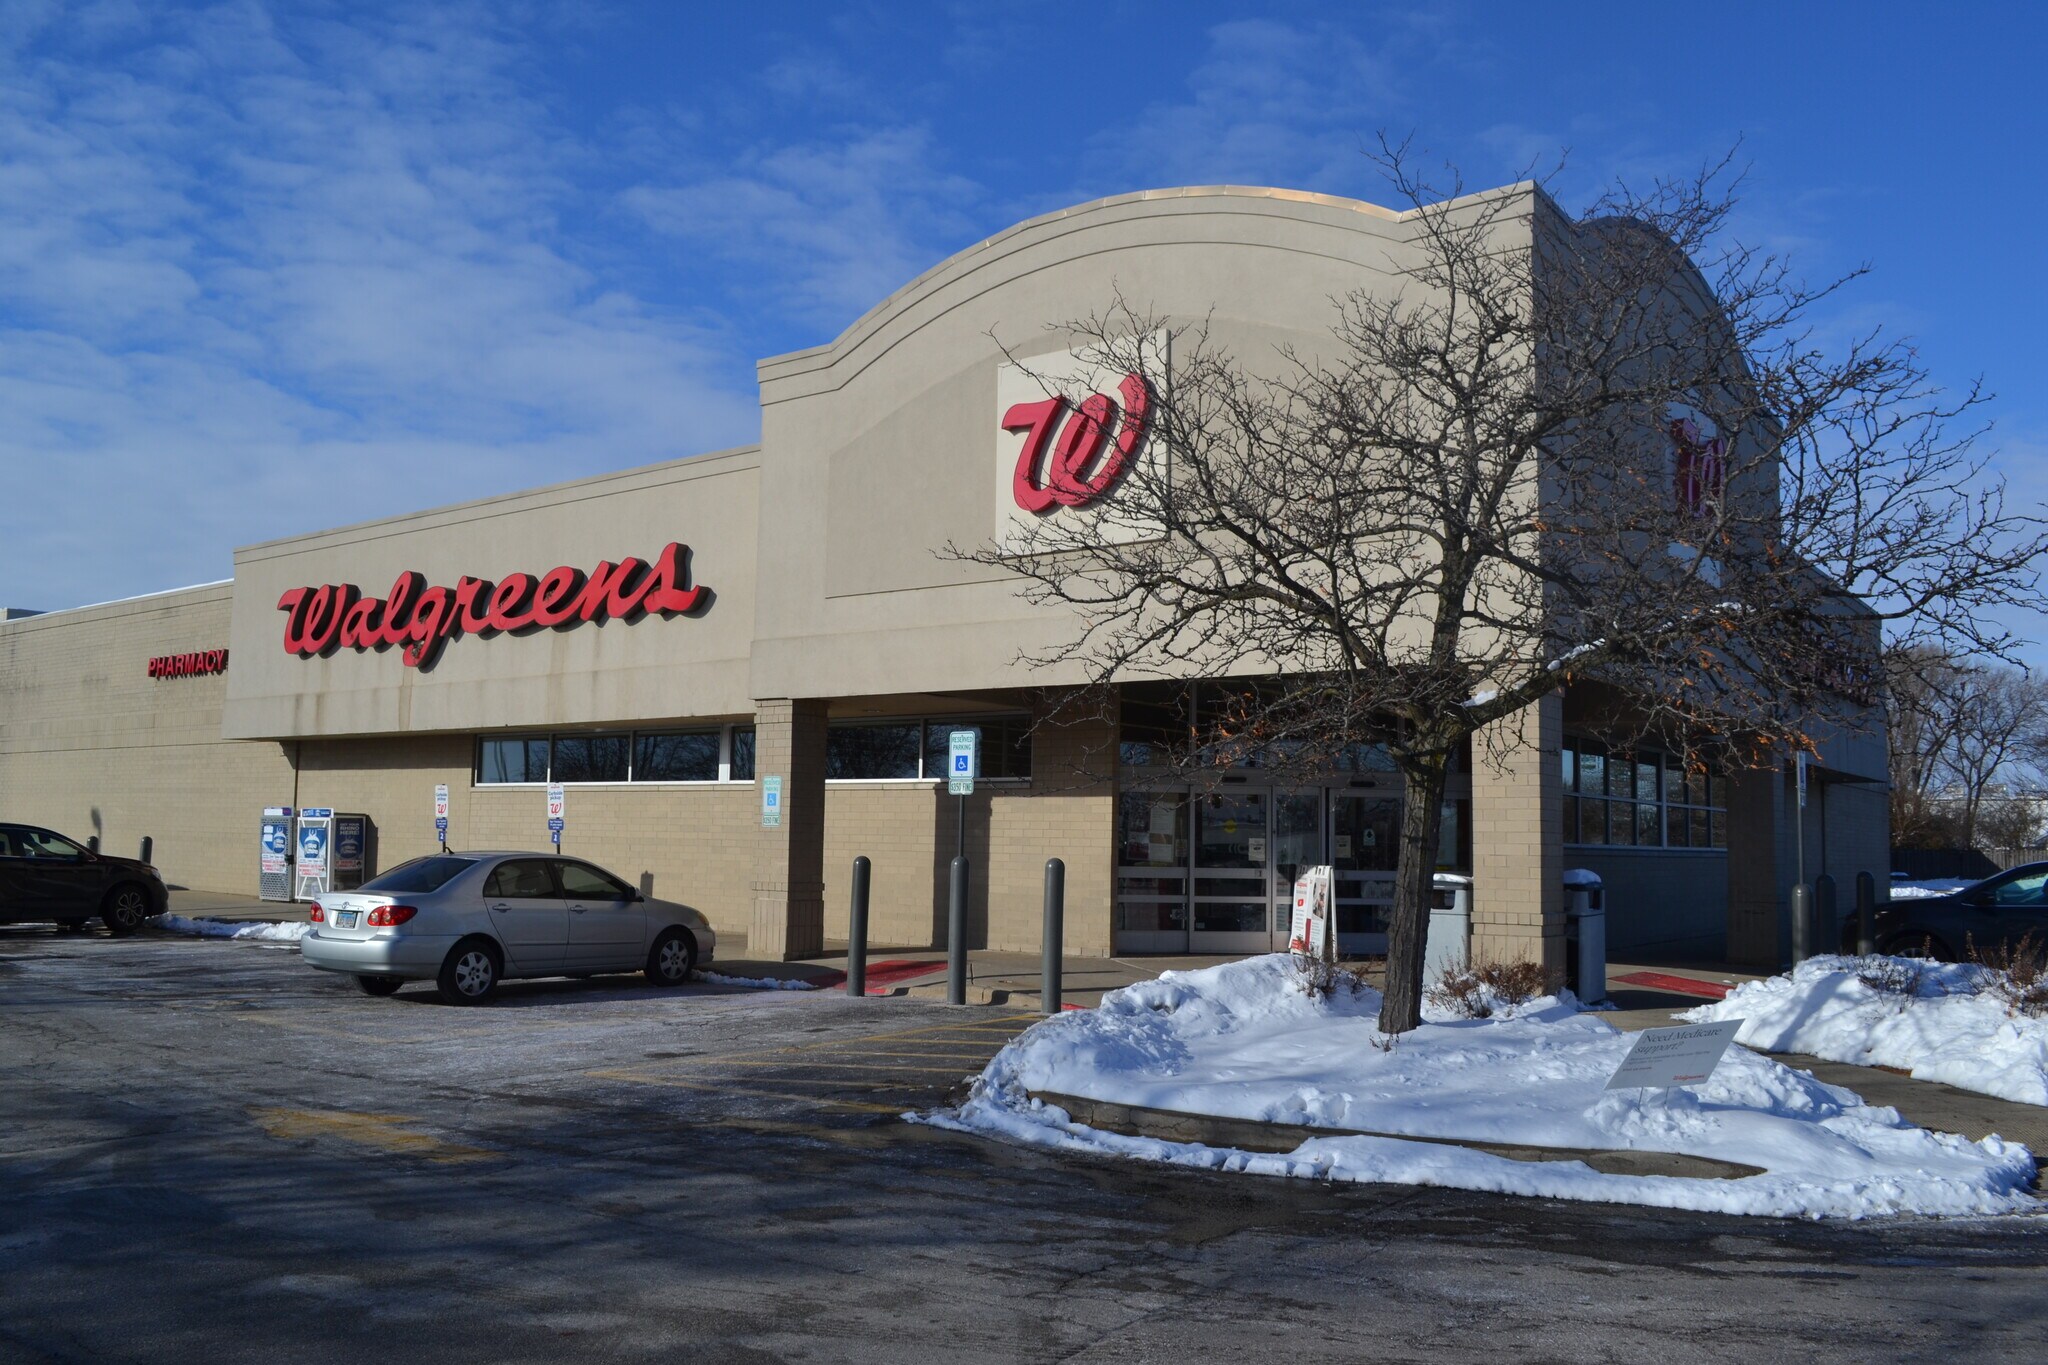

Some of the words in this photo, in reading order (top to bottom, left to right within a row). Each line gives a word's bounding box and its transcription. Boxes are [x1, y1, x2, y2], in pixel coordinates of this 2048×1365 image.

[1002, 372, 1149, 511] W
[277, 542, 704, 668] Walgreens
[148, 649, 225, 677] PHARMACY
[437, 804, 446, 814] W
[550, 803, 561, 814] W
[1643, 1031, 1672, 1044] Need
[1673, 1028, 1723, 1041] Medicare
[1635, 1041, 1685, 1055] support?
